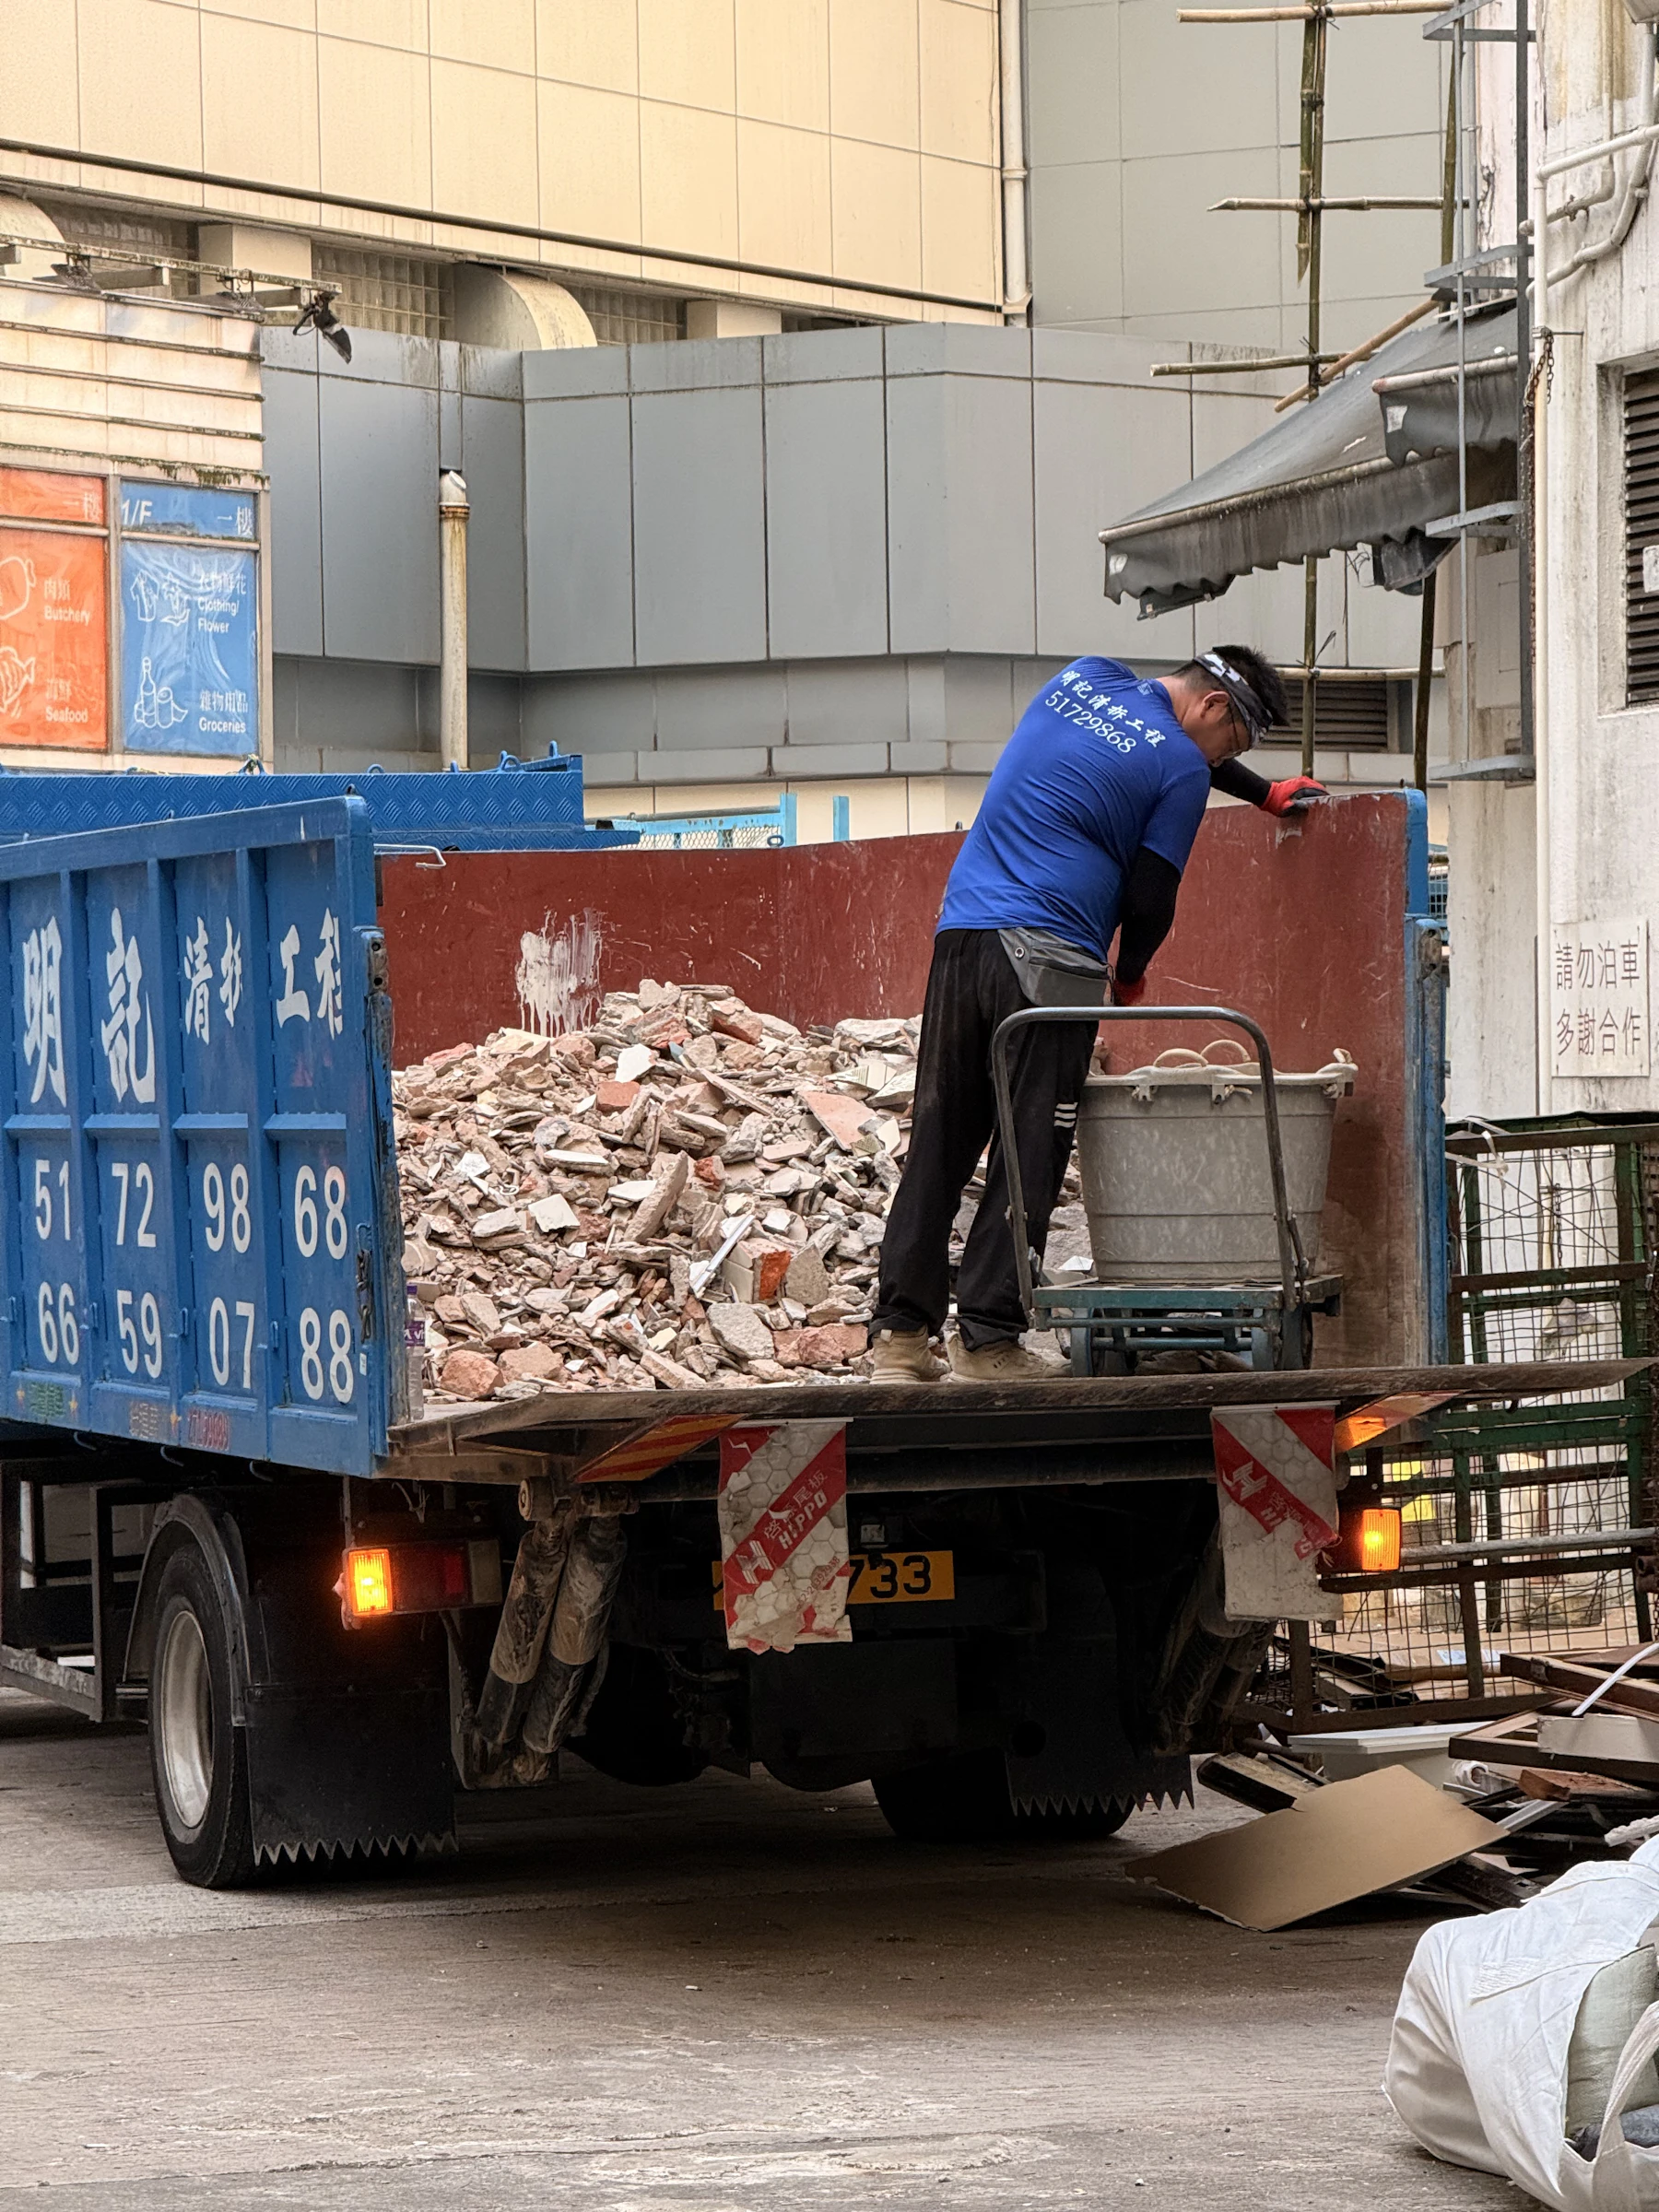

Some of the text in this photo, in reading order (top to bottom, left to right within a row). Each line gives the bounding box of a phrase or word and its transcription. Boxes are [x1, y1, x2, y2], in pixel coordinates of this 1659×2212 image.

[44, 605, 90, 626] Butchery
[197, 618, 229, 633] Flower
[46, 706, 88, 723] Seafood
[199, 716, 246, 734] Groceries
[1045, 690, 1136, 753] 51729868
[1556, 939, 1640, 990] 請勿泊車
[1557, 1006, 1641, 1056] 多謝合作
[778, 1489, 828, 1550] HIPPO
